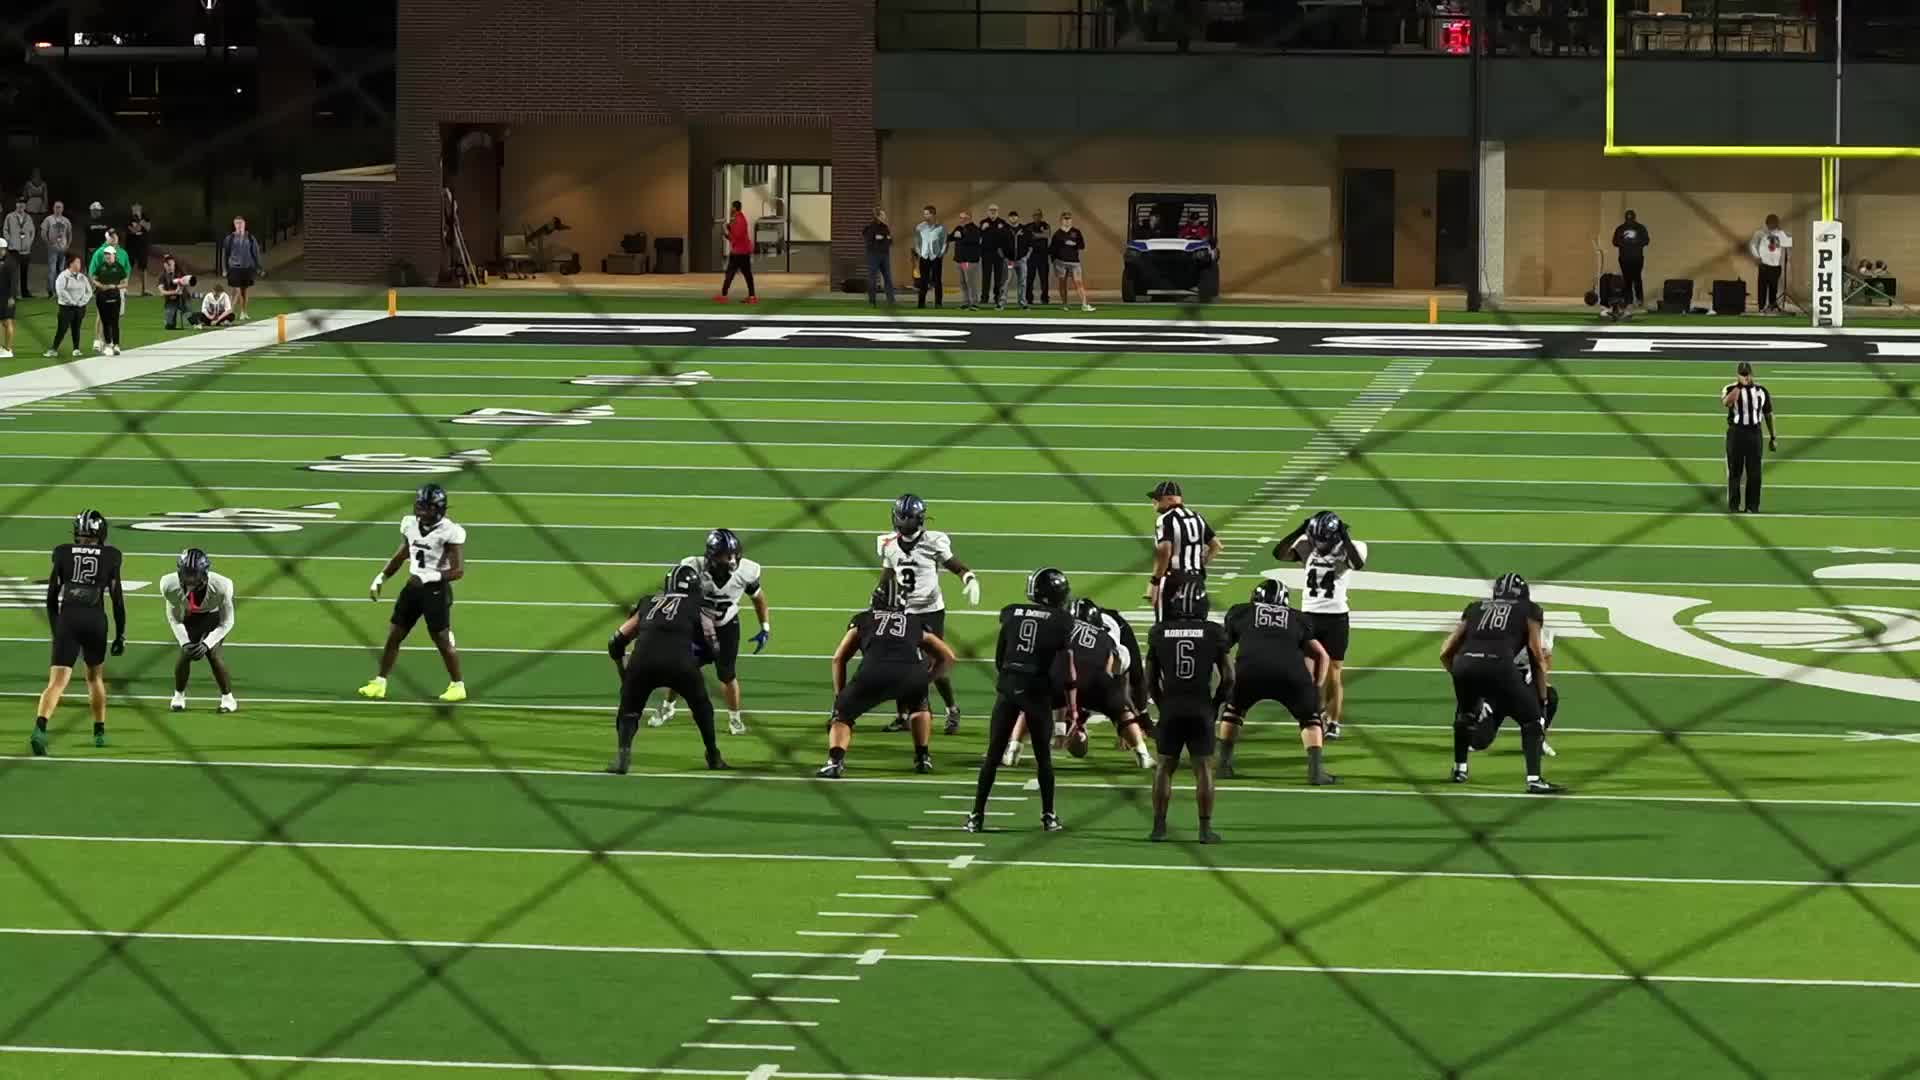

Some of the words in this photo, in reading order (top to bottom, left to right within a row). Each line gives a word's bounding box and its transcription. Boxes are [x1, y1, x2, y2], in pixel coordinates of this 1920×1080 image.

[1818, 249, 1833, 315] PHS
[435, 322, 1920, 356] PROSP
[72, 555, 98, 585] 12
[1307, 568, 1336, 600] 44
[646, 596, 681, 620] 74
[1255, 604, 1288, 630] 63
[1477, 602, 1512, 631] 78
[874, 612, 907, 637] 73
[1016, 619, 1038, 653] 9
[1176, 640, 1195, 679] 6
